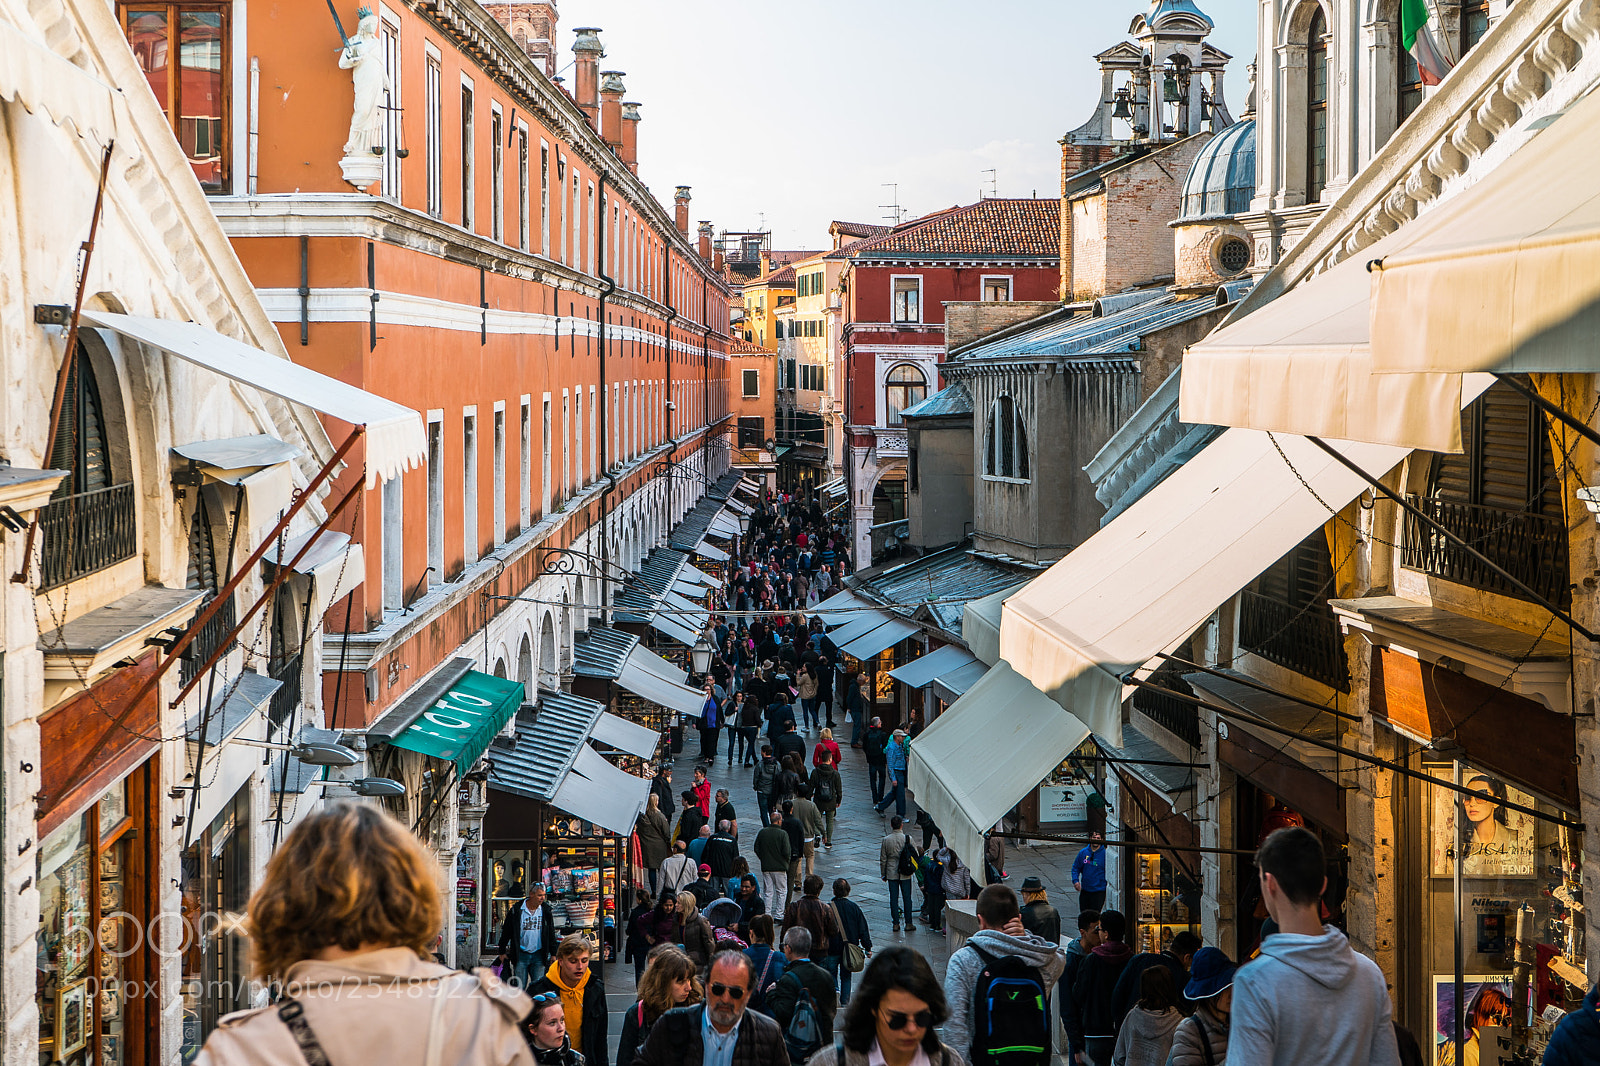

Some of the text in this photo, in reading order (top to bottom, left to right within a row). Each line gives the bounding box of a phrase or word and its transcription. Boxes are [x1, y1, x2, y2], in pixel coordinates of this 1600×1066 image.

[408, 691, 493, 742] FOTO
[1501, 864, 1530, 874] FENDI
[1471, 898, 1510, 907] Nikon
